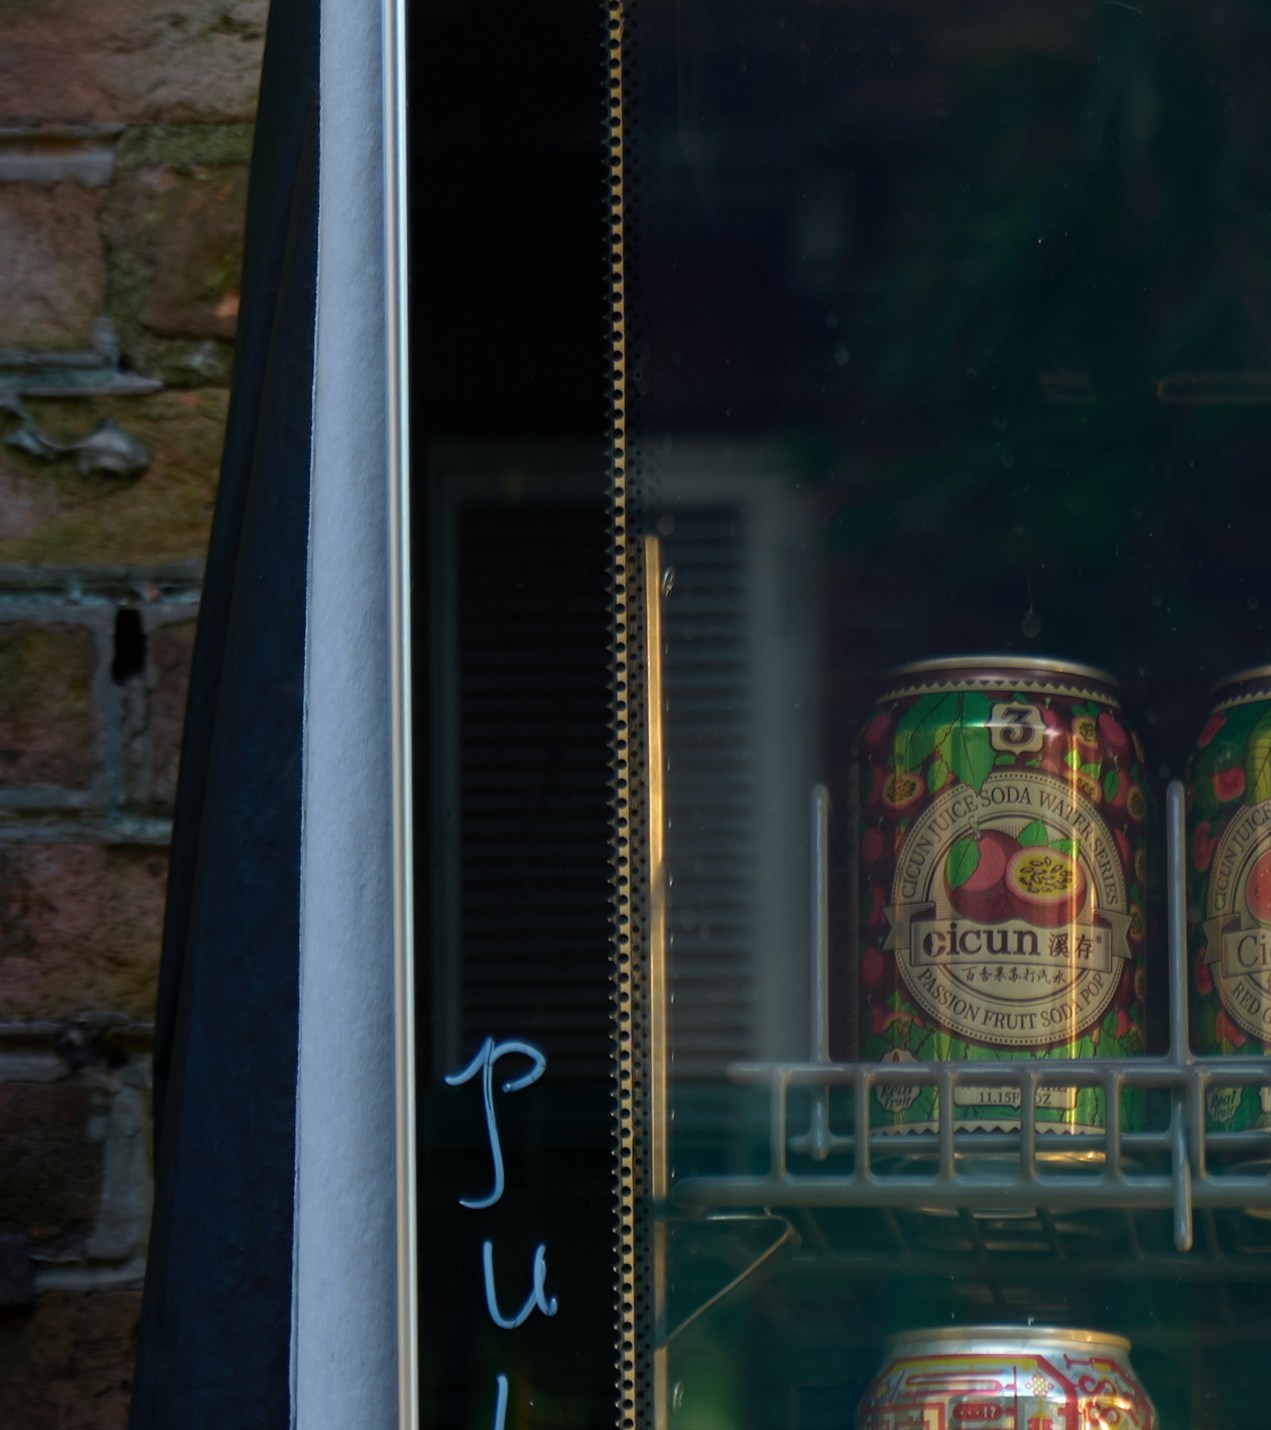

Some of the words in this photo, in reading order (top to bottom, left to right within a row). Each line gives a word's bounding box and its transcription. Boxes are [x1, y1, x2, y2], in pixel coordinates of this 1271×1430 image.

[927, 796, 978, 840] JUICE
[981, 784, 1032, 809] SODA
[1038, 787, 1092, 842] WATER
[1048, 932, 1095, 959] 溪存
[916, 967, 980, 1021] PASSION
[982, 1011, 1037, 1031] FRUIT
[1040, 1001, 1083, 1027] SODA
[1081, 972, 1105, 1008] POP
[1231, 981, 1261, 1015] RED
